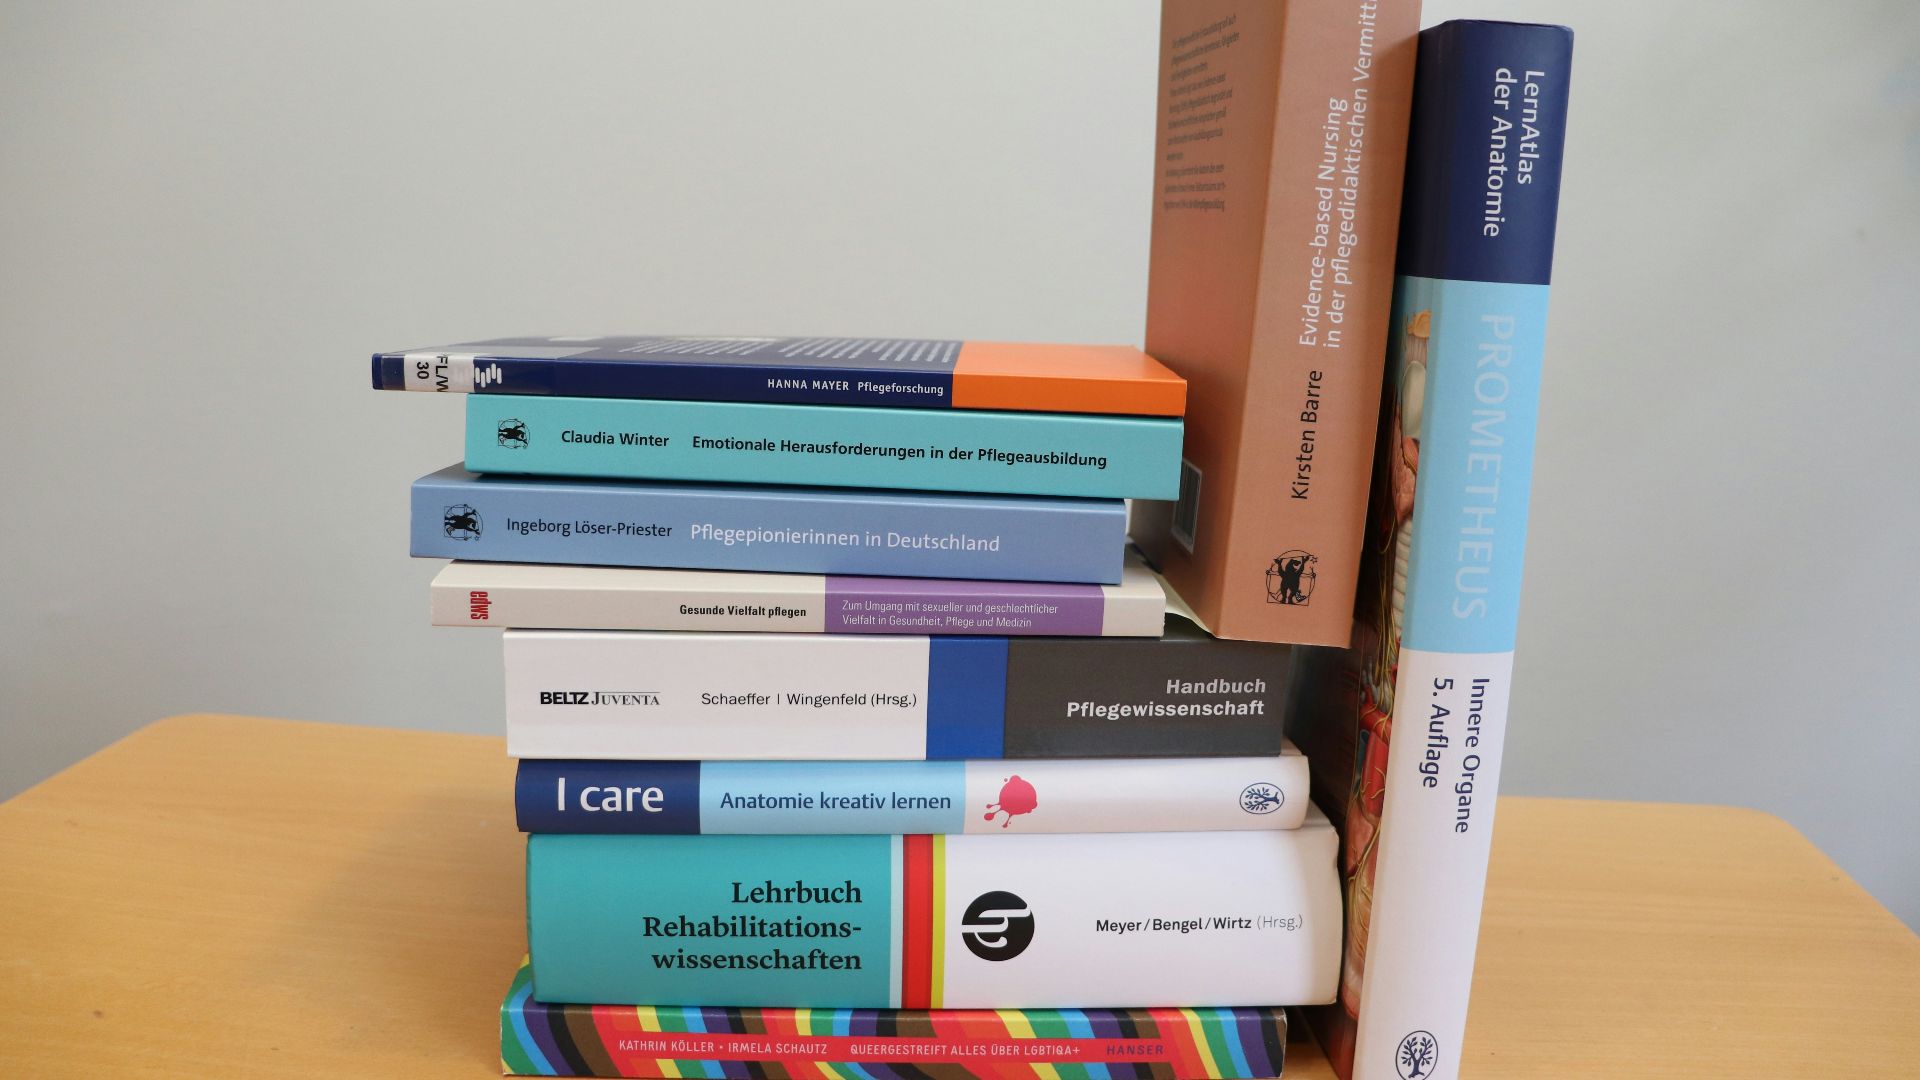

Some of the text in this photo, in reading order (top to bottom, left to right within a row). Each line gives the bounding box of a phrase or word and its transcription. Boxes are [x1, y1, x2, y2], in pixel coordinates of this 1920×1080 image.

[1517, 70, 1545, 185] LernAtlas
[1483, 67, 1518, 237] der Anatomie
[1323, 0, 1378, 348] in der pflegedidaktischen Vermitt
[1299, 97, 1348, 346] Evidence-based Nursing
[416, 361, 430, 380] 30
[767, 378, 944, 396] HANNA MAYER Pflegeforschung
[1291, 370, 1323, 500] Kirsten Barre
[561, 430, 1108, 470] Claudia Winter Emotionale Herausforderungen in der Pflegeausbildung
[1452, 314, 1516, 619] PROMETHEUS
[506, 518, 1000, 552] Ingeborg Löser-Priester Pflegepionierinnen in Deutschland
[679, 604, 808, 620] Gesunde Vielfalt pflegen
[842, 600, 1059, 618] Zum Umgang mit sexueller und geschlechtlicher
[842, 614, 1032, 629] Vielfalt in Gesundheit, Pflege und Medizin
[1166, 678, 1267, 694] Handbuch
[539, 691, 590, 706] BELTZ
[701, 692, 771, 706] Schaeffer
[786, 692, 867, 708] Wingenfeld
[870, 692, 918, 708] (Hrsg.)
[1066, 700, 1265, 720] Pflegewissenschaft
[1418, 677, 1454, 788] 5. Auflage
[1454, 678, 1491, 833] Innere Organe
[578, 782, 665, 813] care
[719, 791, 815, 811] Anatomie
[819, 791, 887, 811] kreativ
[891, 792, 952, 811] lernen
[731, 880, 863, 904] Lehrbuch
[642, 914, 863, 938] Rehabilitations-
[1256, 913, 1304, 931] (Hrsg.)
[651, 947, 863, 970] wissenschaften
[619, 1038, 1164, 1056] KATHRIN KÖLLER IRMELA SCHAUTZ QUEERGESTREIFT ALLES ÜBER LGBTIQA+ HANSER
